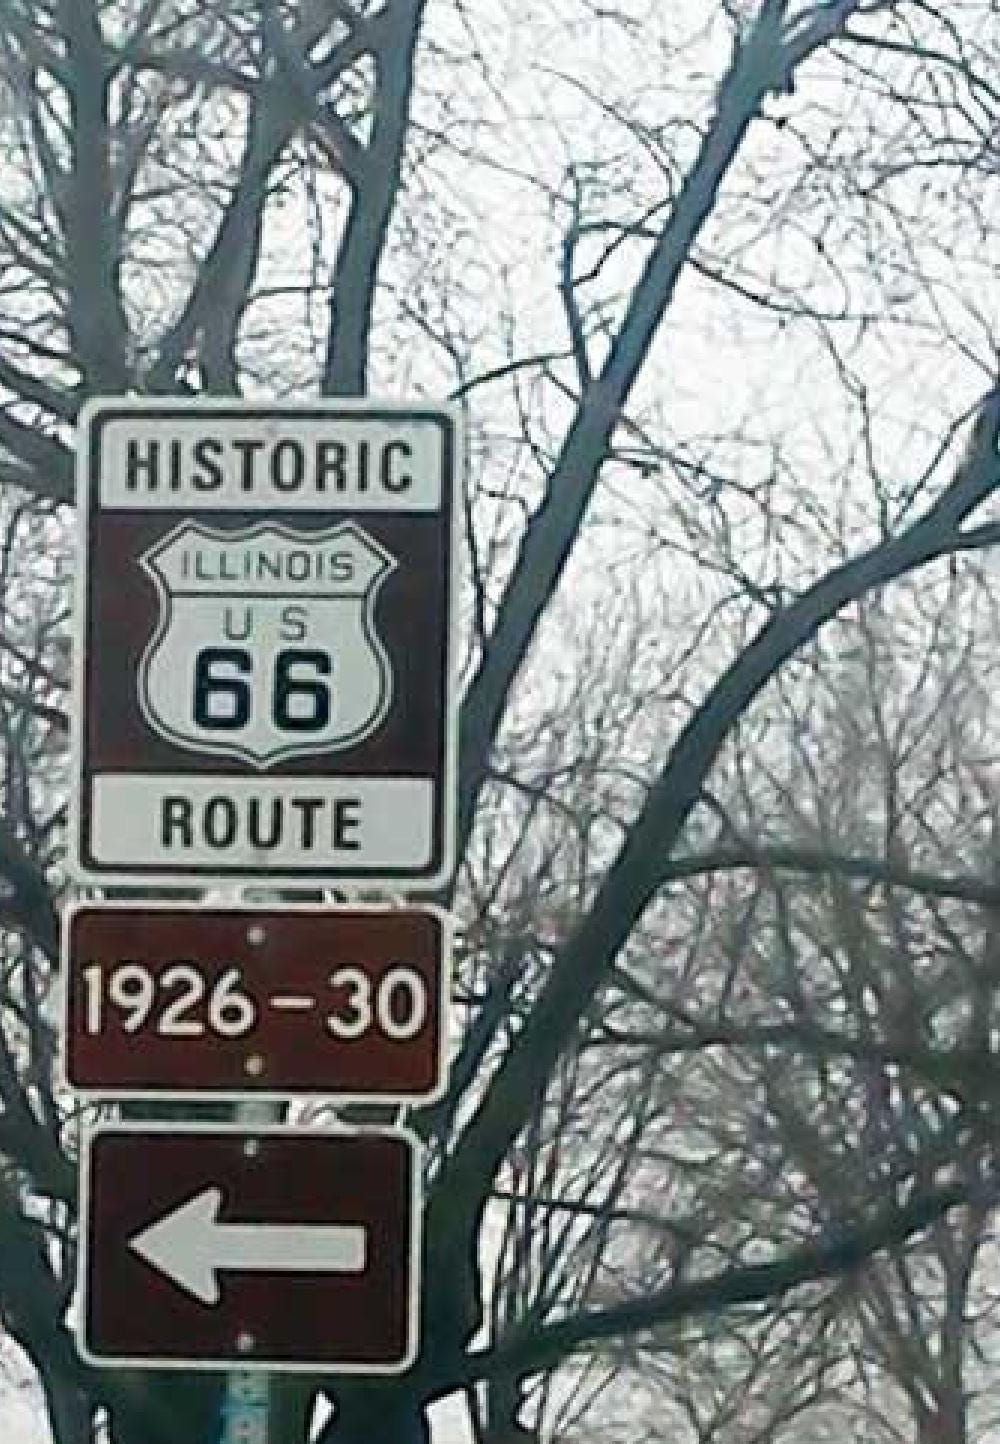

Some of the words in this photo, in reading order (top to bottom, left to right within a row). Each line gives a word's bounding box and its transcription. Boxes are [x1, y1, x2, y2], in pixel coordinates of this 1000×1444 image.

[126, 438, 414, 493] HISTORIC
[182, 550, 355, 582] ILLINOIS
[192, 648, 332, 731] 66
[161, 796, 362, 851] ROUTE
